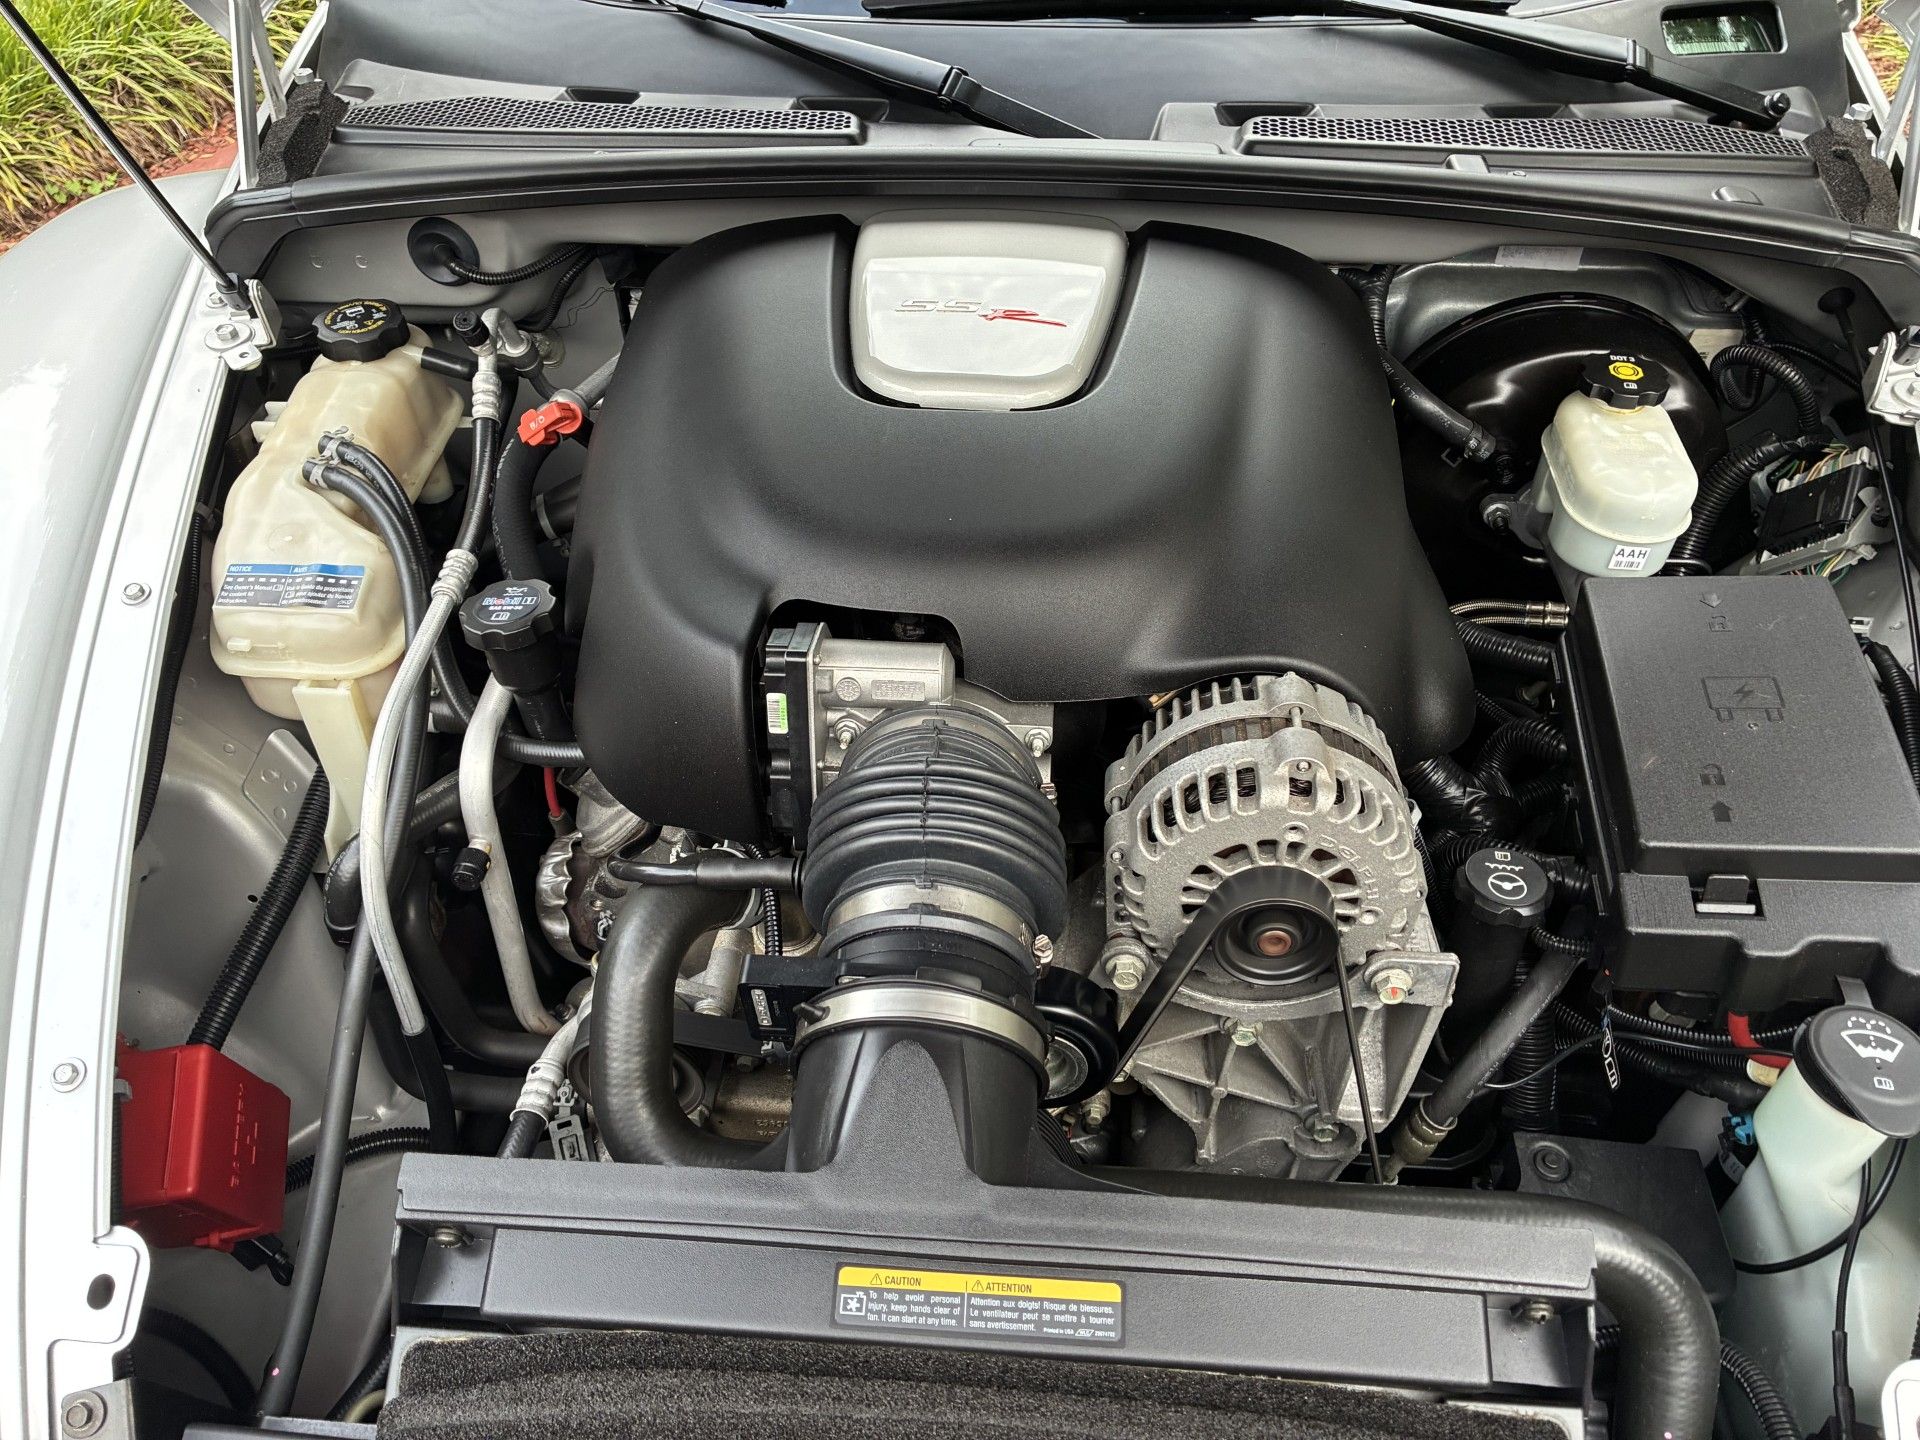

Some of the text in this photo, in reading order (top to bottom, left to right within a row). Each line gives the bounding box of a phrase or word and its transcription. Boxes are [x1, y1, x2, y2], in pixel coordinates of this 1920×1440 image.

[895, 299, 1067, 327] SSR
[1615, 548, 1648, 559] AAH
[885, 1275, 921, 1286] CAUTION
[985, 1282, 1032, 1293] ATTENTION
[869, 1290, 961, 1304] To help avoid personal
[891, 1303, 908, 1313] keep
[910, 1304, 931, 1314] hands
[933, 1306, 950, 1315] clear
[953, 1306, 960, 1315] of
[970, 1296, 1114, 1314] Attention aux doigts! Risque de blessures.
[867, 1313, 958, 1327] fan. It can start at any time.
[970, 1308, 1114, 1325] Le ventilateur peut se mettre à tourner
[969, 1320, 1036, 1332] sans avertissement.
